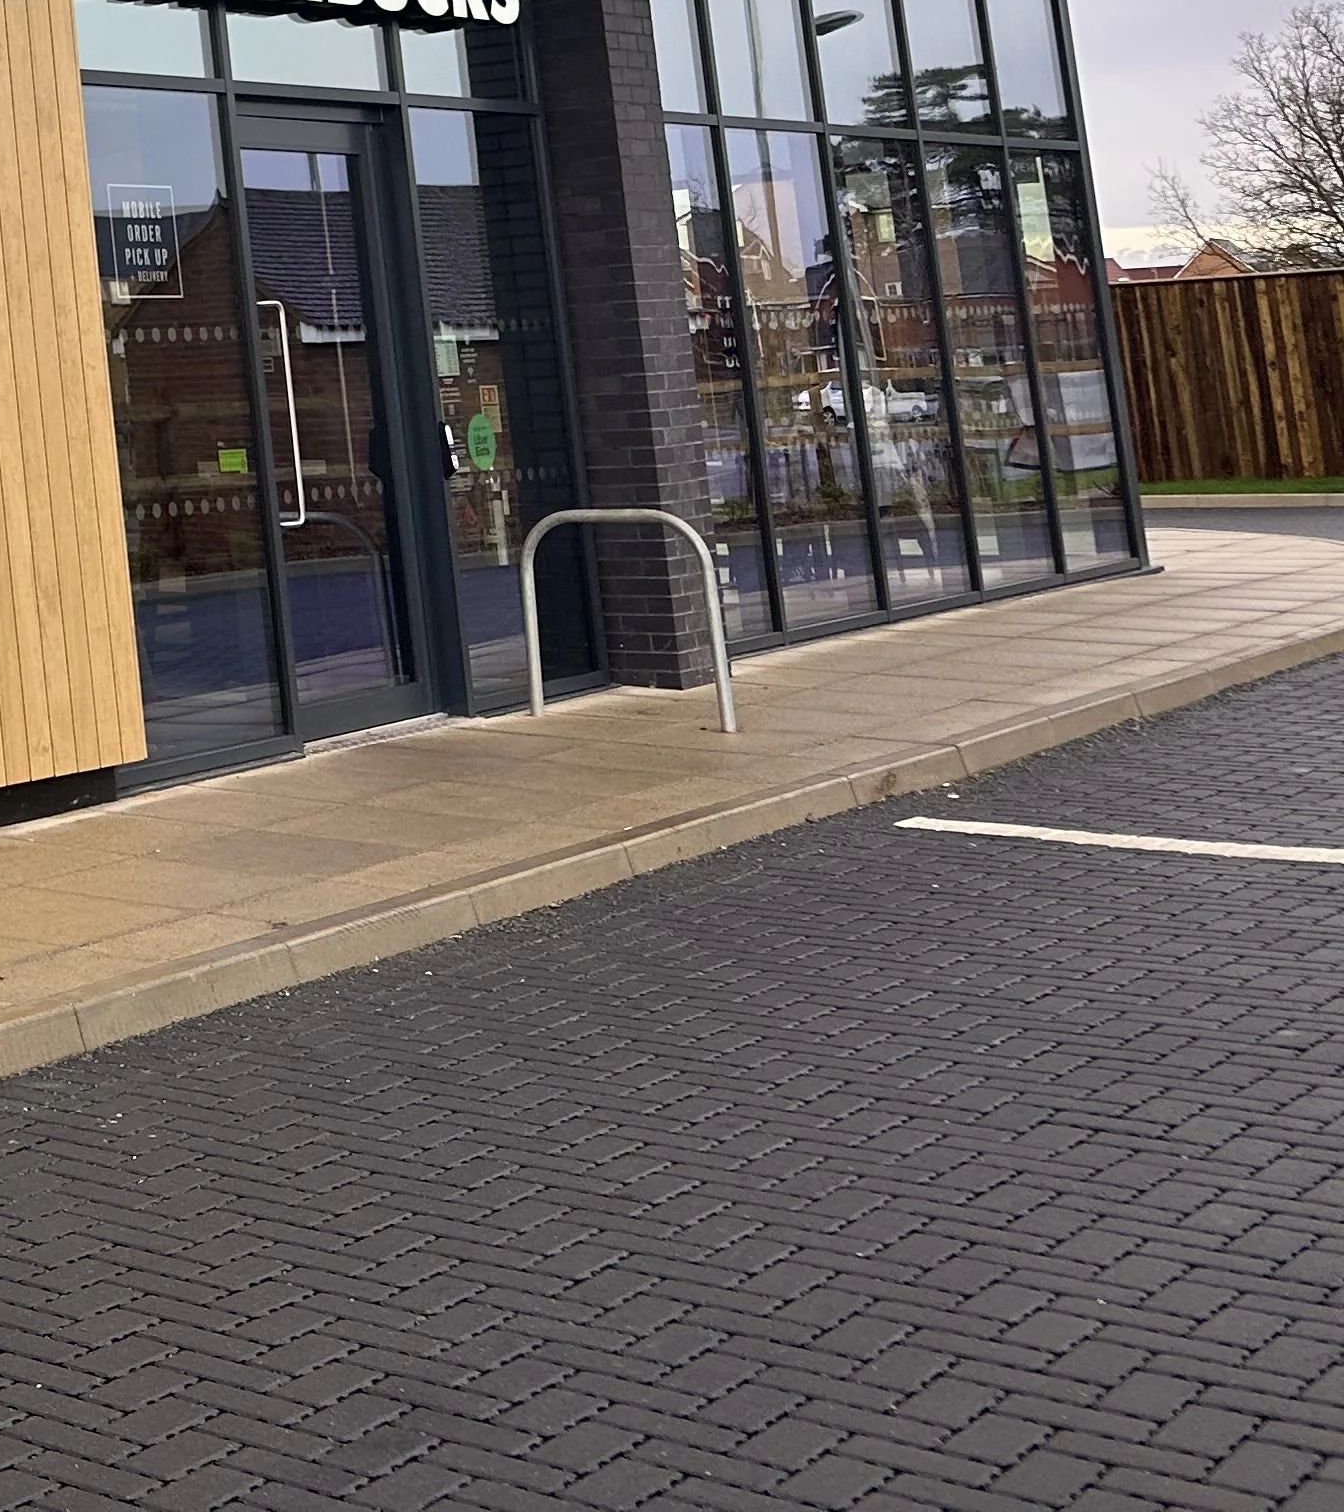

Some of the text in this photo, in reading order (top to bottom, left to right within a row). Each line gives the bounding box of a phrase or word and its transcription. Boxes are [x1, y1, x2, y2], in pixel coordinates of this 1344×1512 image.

[122, 200, 162, 219] MOBILE
[126, 224, 162, 242] ORDER
[124, 248, 168, 266] PICK UP
[137, 270, 168, 283] DELIVERY
